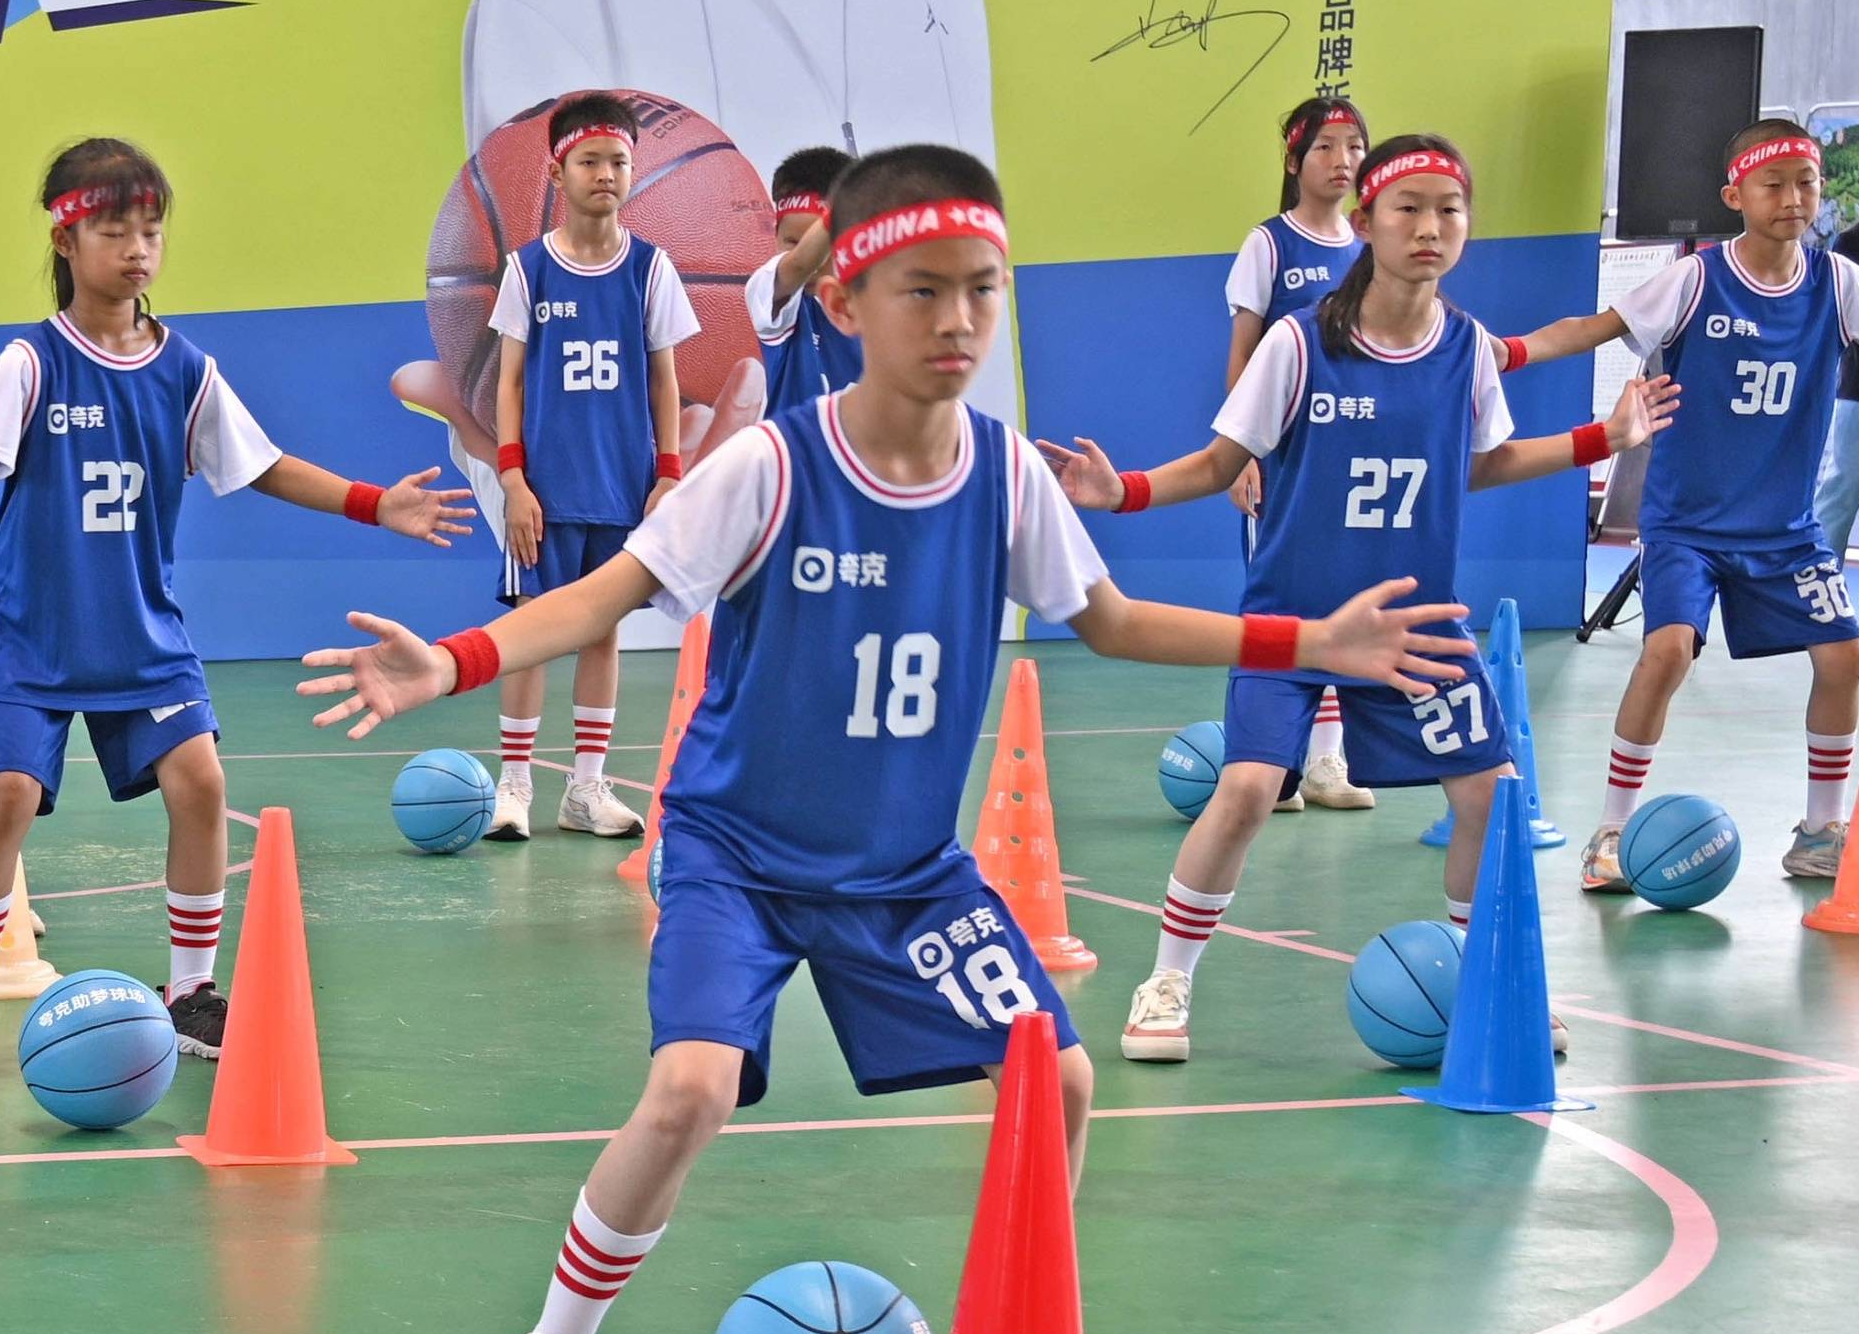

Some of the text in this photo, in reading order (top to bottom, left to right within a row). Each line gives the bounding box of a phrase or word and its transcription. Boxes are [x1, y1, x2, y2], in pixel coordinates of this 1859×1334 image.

[1371, 154, 1430, 187] CHINA
[1739, 142, 1790, 170] CHINA
[852, 208, 939, 260] CHINA
[552, 302, 577, 318] 夸克
[1732, 318, 1760, 338] 夸克
[563, 341, 619, 392] 26
[1731, 361, 1797, 416] 30
[69, 405, 105, 429] 夸克
[1339, 397, 1375, 420] 夸克
[82, 461, 145, 533] 22
[1344, 458, 1428, 529] 27
[838, 552, 887, 587] 夸克
[1797, 573, 1855, 624] 30
[846, 634, 941, 738] 18
[1412, 682, 1489, 755] 27
[945, 906, 1006, 948] 夸克
[38, 987, 146, 1028] 夸克助梦球场
[935, 944, 1039, 1030] 18
